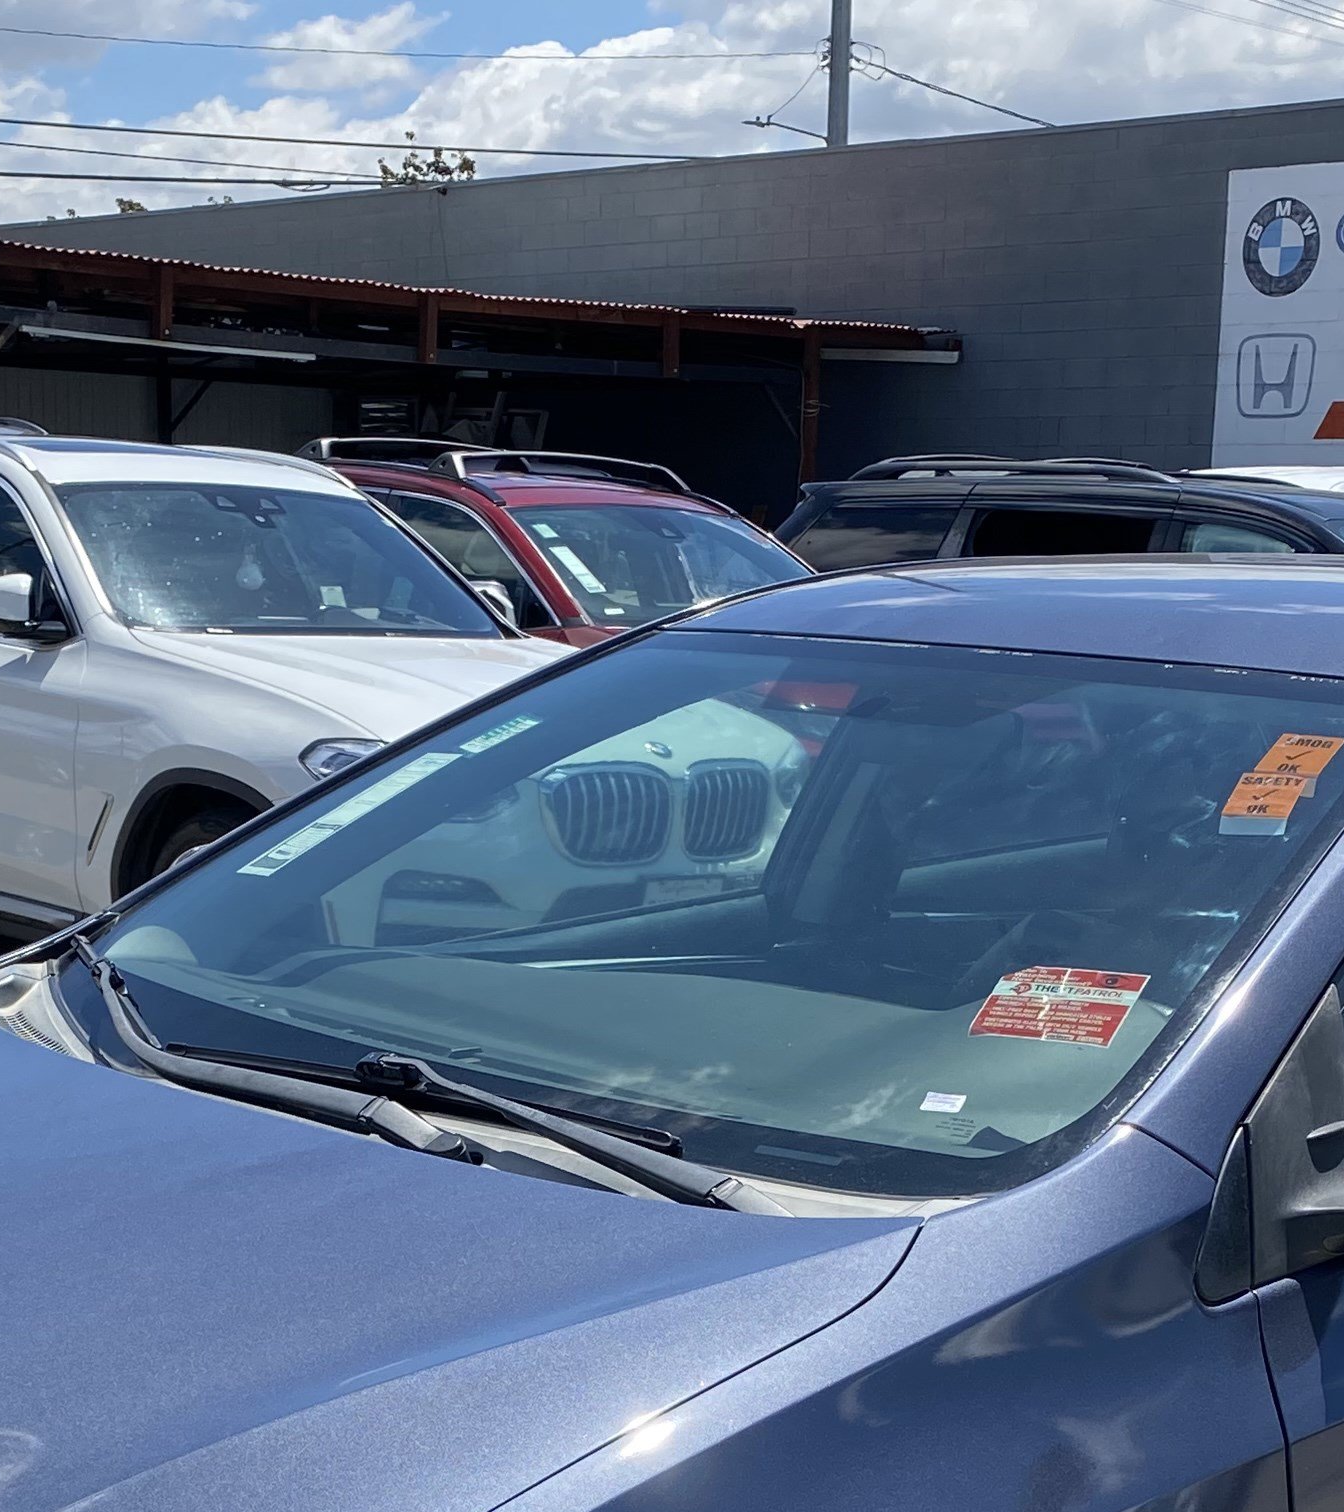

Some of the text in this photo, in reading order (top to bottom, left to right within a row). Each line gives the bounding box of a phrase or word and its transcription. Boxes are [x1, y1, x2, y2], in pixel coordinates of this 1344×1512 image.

[1250, 199, 1317, 242] BMW
[1286, 736, 1335, 749] SMOG
[1276, 763, 1302, 774] OK
[1246, 804, 1269, 814] OK
